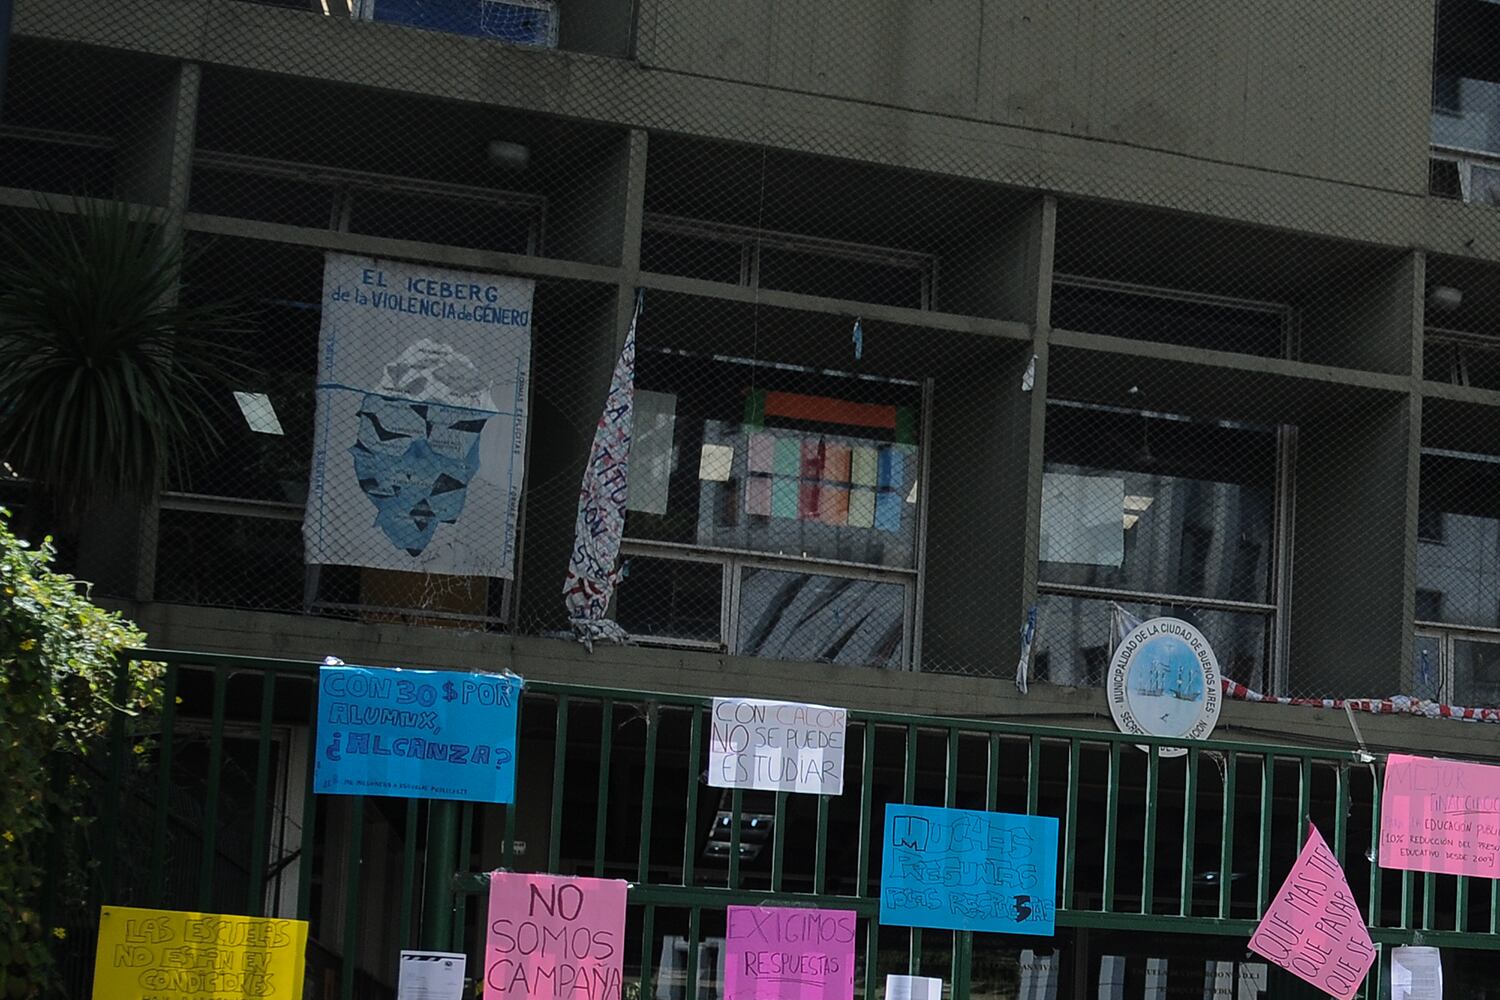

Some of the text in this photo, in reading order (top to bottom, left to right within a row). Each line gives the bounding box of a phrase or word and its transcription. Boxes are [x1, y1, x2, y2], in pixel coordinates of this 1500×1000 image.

[362, 268, 498, 302] EL ICEBERG
[331, 286, 529, 327] de la VIOLENCIA de GÉNERO
[1114, 623, 1216, 713] MUNICIPALIDAD DE LA CIUDAD DE BUENOS AIRES
[324, 673, 391, 699] CON
[396, 679, 438, 707] 30
[462, 680, 514, 707] POR
[716, 701, 845, 728] CON CALOR
[712, 722, 843, 753] NO SE PUEDE
[529, 882, 584, 921] NO
[1284, 873, 1328, 916] MÁS
[126, 916, 290, 948] LAS ESCUELAS
[492, 919, 614, 961] SOMOS
[728, 909, 855, 945] EXIGIMOS
[113, 944, 153, 967] NO
[241, 951, 272, 972] EN
[744, 951, 839, 977] RESPUESTAS
[1292, 939, 1332, 978] QUE
[1325, 937, 1374, 996] QUE SE
[138, 968, 276, 997] CONDICIONES
[487, 959, 621, 1000] CAMPAÑA
